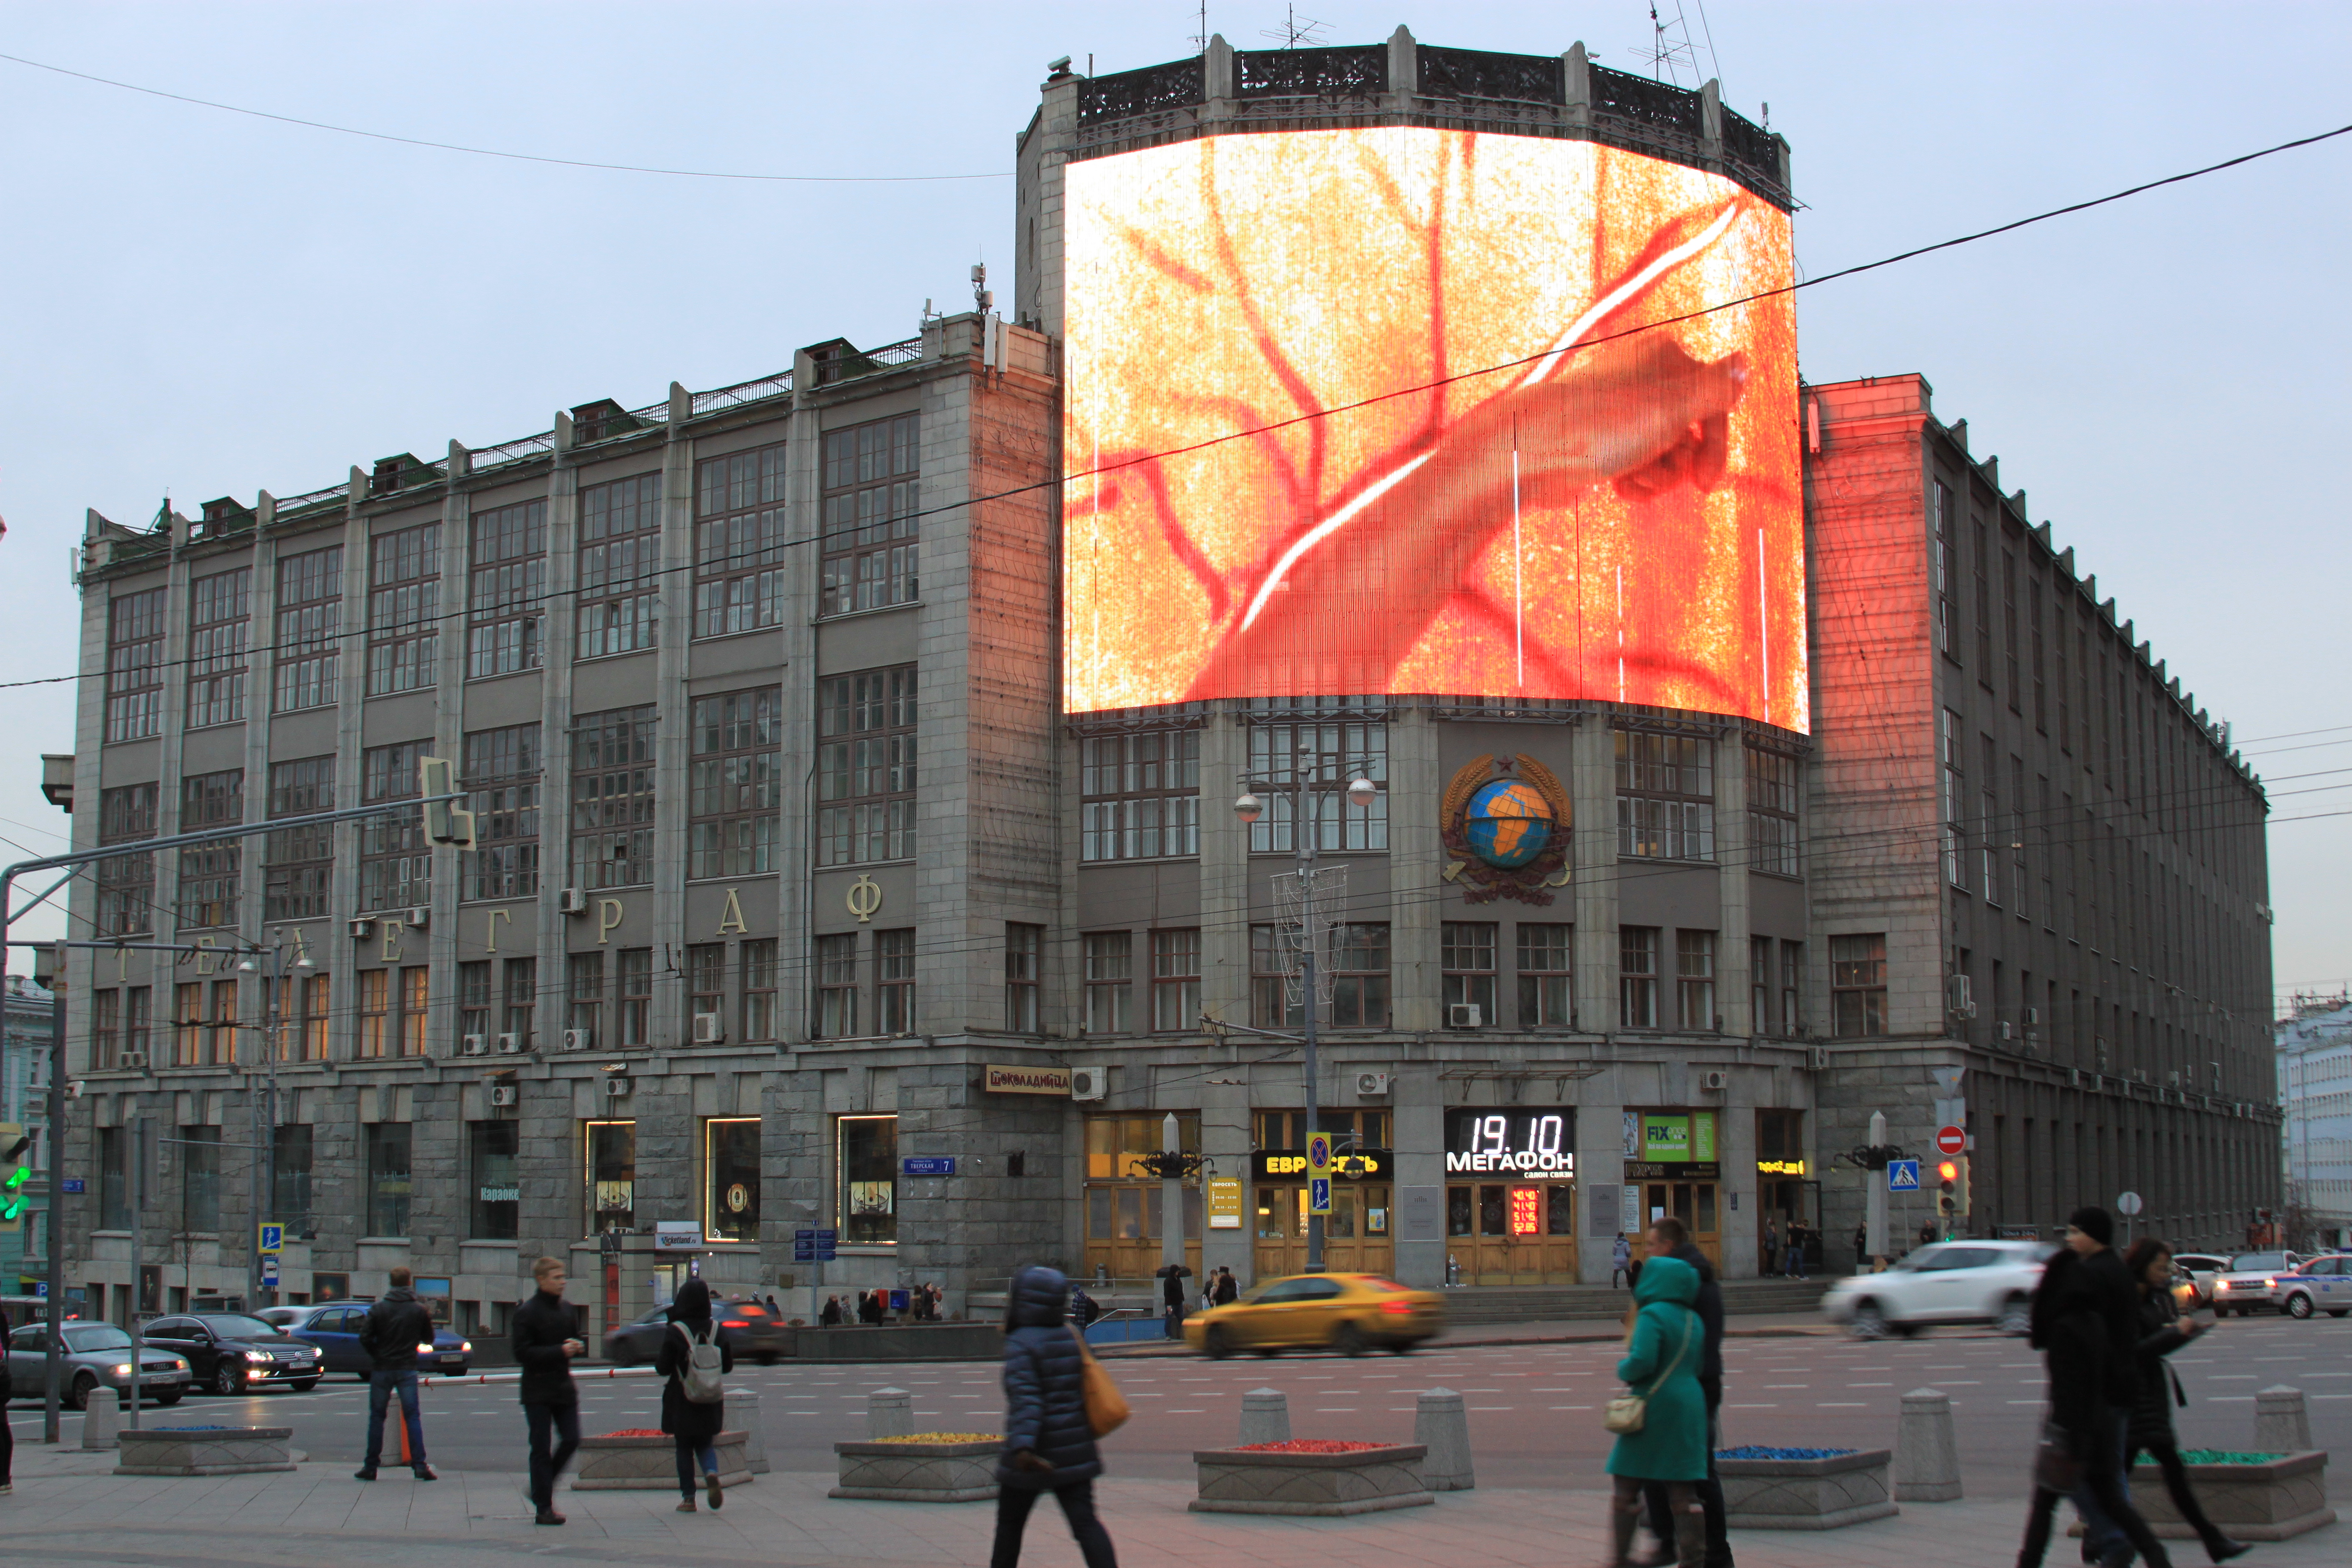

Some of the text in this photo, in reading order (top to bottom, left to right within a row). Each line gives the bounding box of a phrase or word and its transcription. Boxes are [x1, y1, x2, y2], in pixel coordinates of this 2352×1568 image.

[943, 1161, 950, 1171] 7
[1267, 1156, 1378, 1173] ЕВРСЕЬ
[481, 1187, 519, 1202] Караоке
